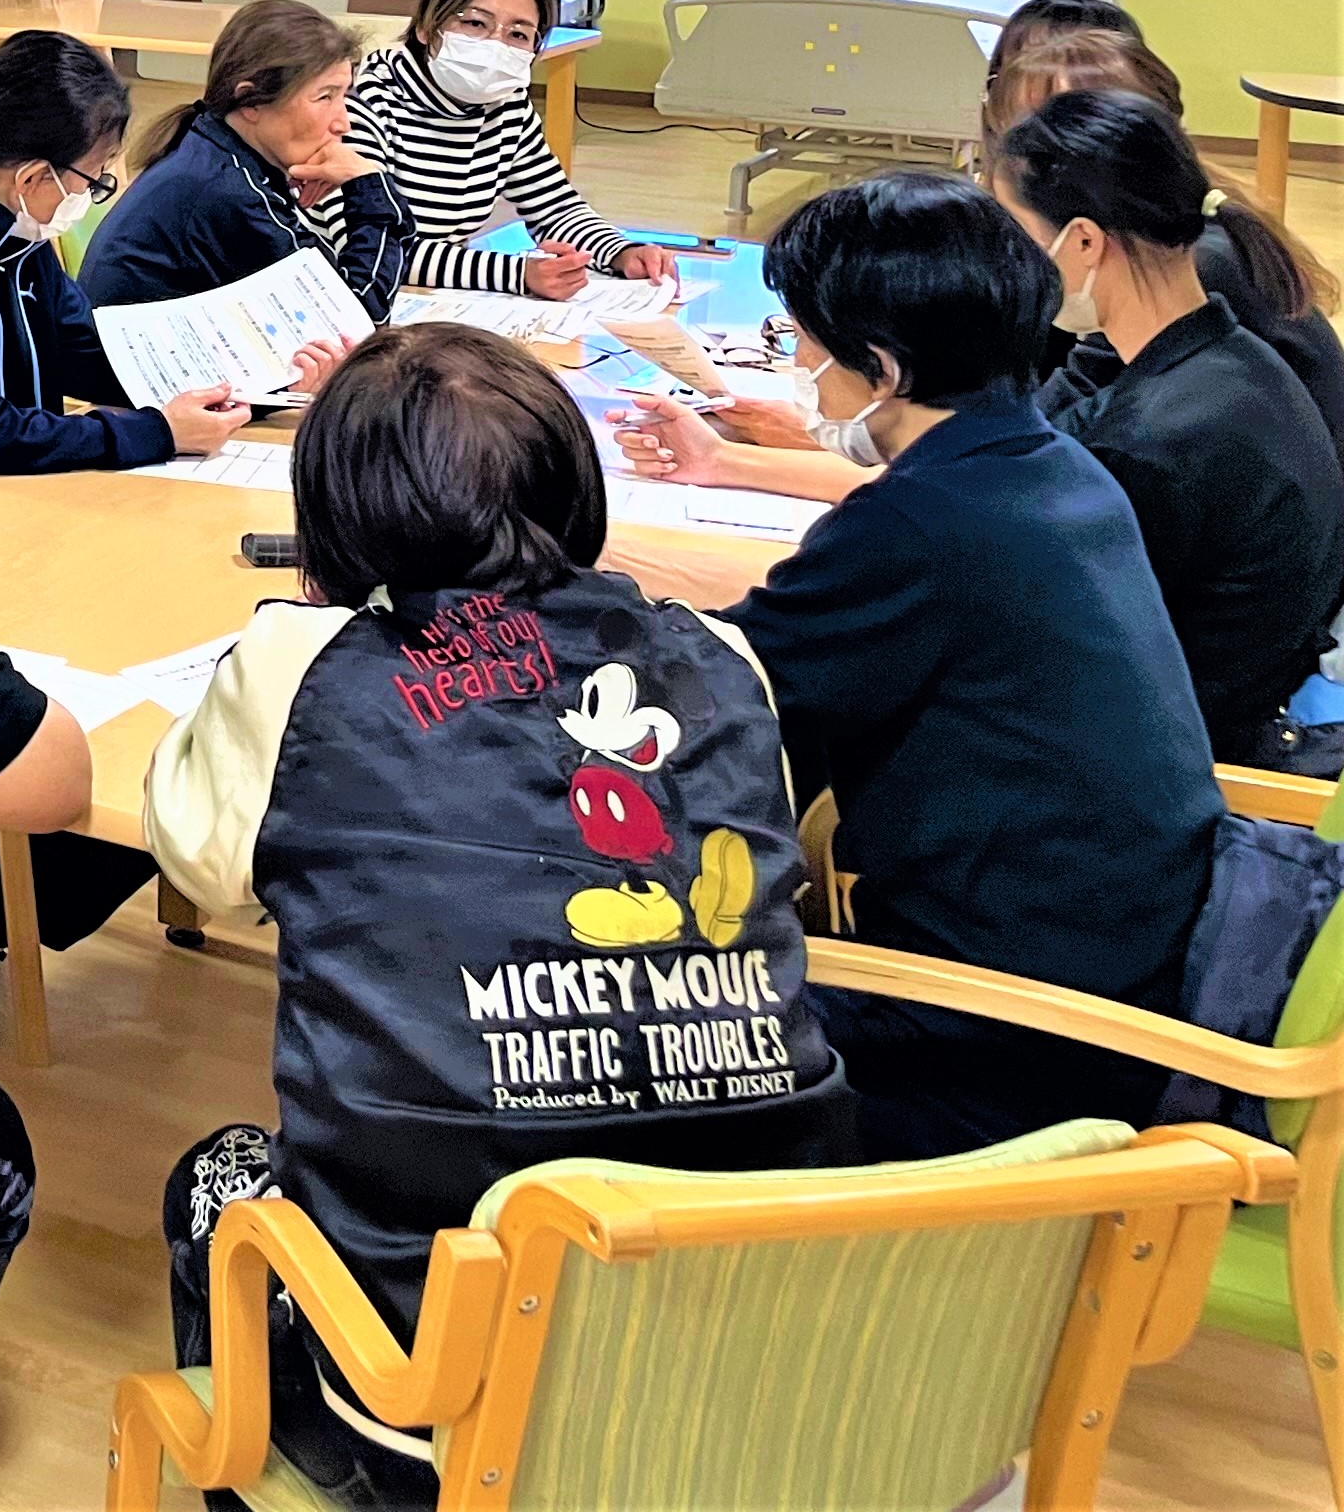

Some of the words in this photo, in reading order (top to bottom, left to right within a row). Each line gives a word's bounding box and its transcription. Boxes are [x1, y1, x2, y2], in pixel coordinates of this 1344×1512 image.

[463, 593, 509, 623] the
[400, 634, 472, 674] hero
[469, 621, 500, 655] of
[497, 610, 543, 648] our
[393, 640, 560, 731] hearts!
[460, 955, 635, 1021] MICKEY
[643, 949, 781, 1013] MOUSE
[482, 1027, 624, 1085] TRAFFIC
[639, 1015, 790, 1078] TROUBLES
[493, 1084, 608, 1110] Produced
[610, 1084, 641, 1111] by
[651, 1079, 718, 1104] WALT
[727, 1070, 797, 1099] DISNEY
